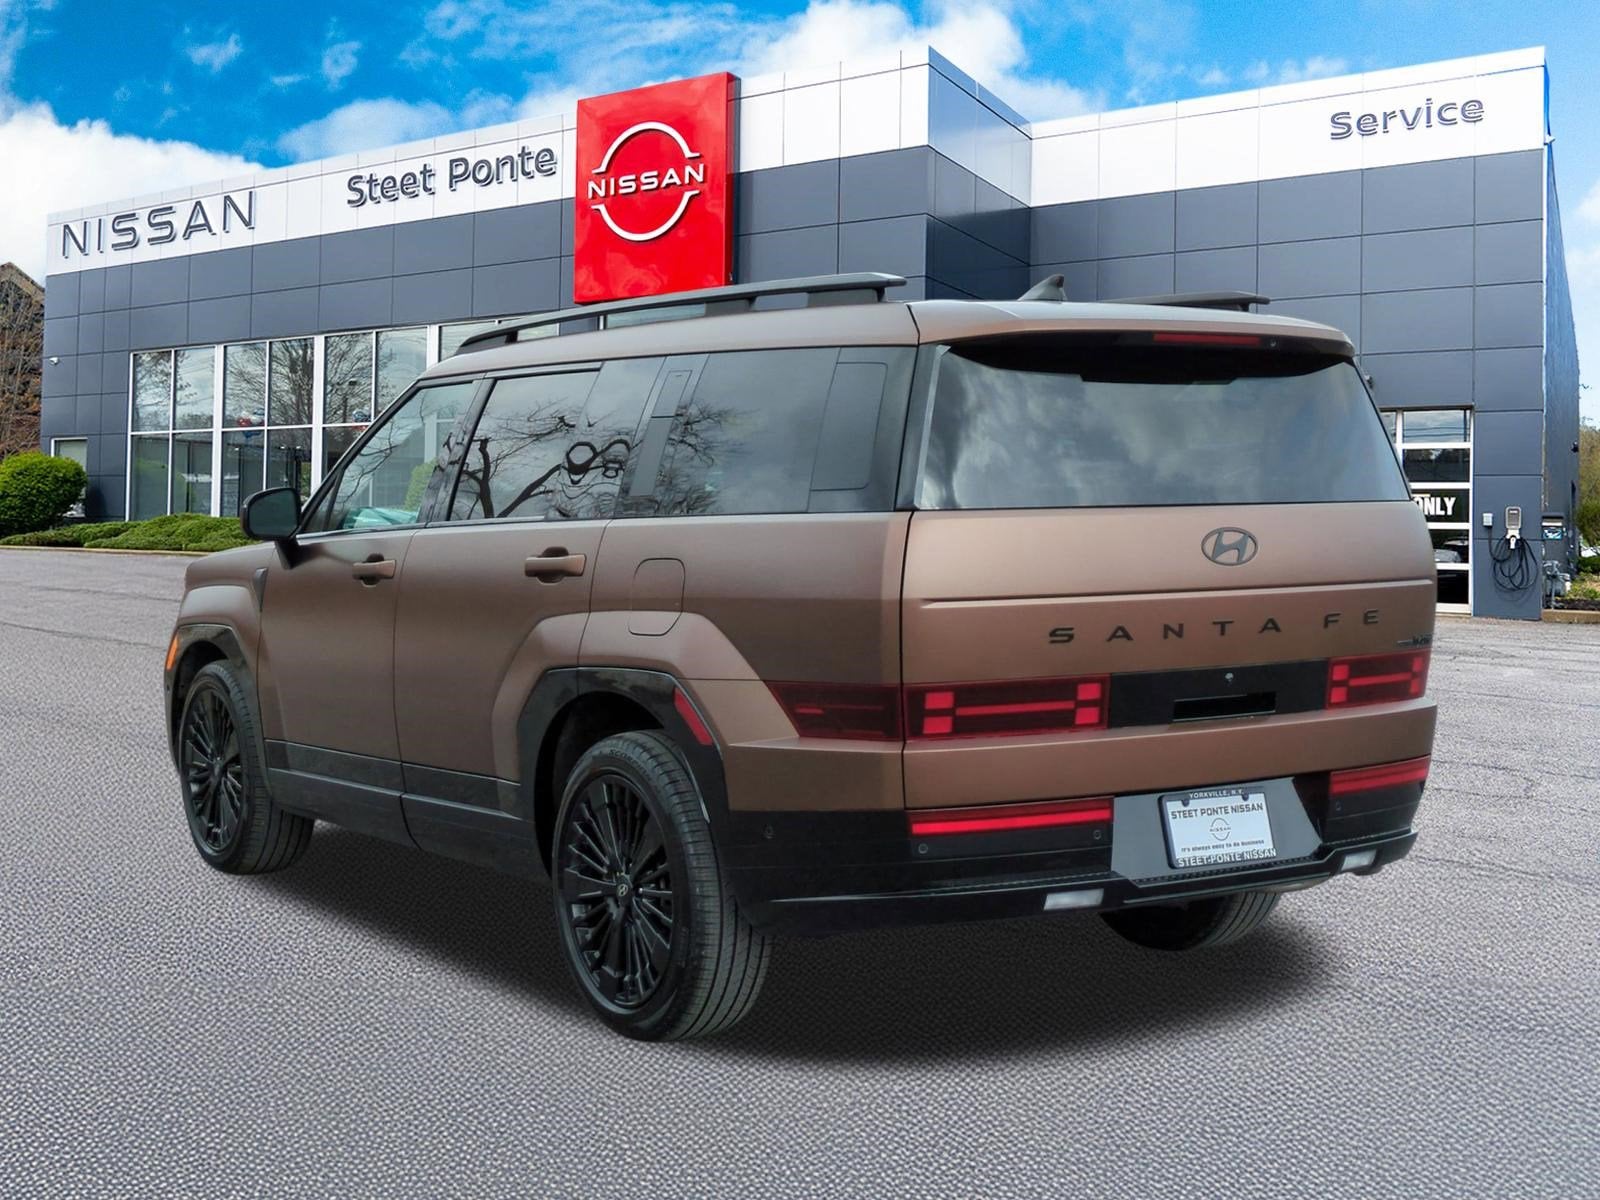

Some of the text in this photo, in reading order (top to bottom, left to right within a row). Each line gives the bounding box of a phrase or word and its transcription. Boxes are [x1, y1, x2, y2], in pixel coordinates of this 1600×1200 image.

[1330, 98, 1484, 140] Service
[347, 146, 557, 207] Steet Ponte
[587, 163, 704, 199] NISSAN
[62, 191, 255, 259] NISSAN
[1049, 609, 1379, 644] SANTA FE
[1171, 802, 1263, 820] STEET PONTE NISSAN
[1244, 848, 1277, 860] NISSAN
